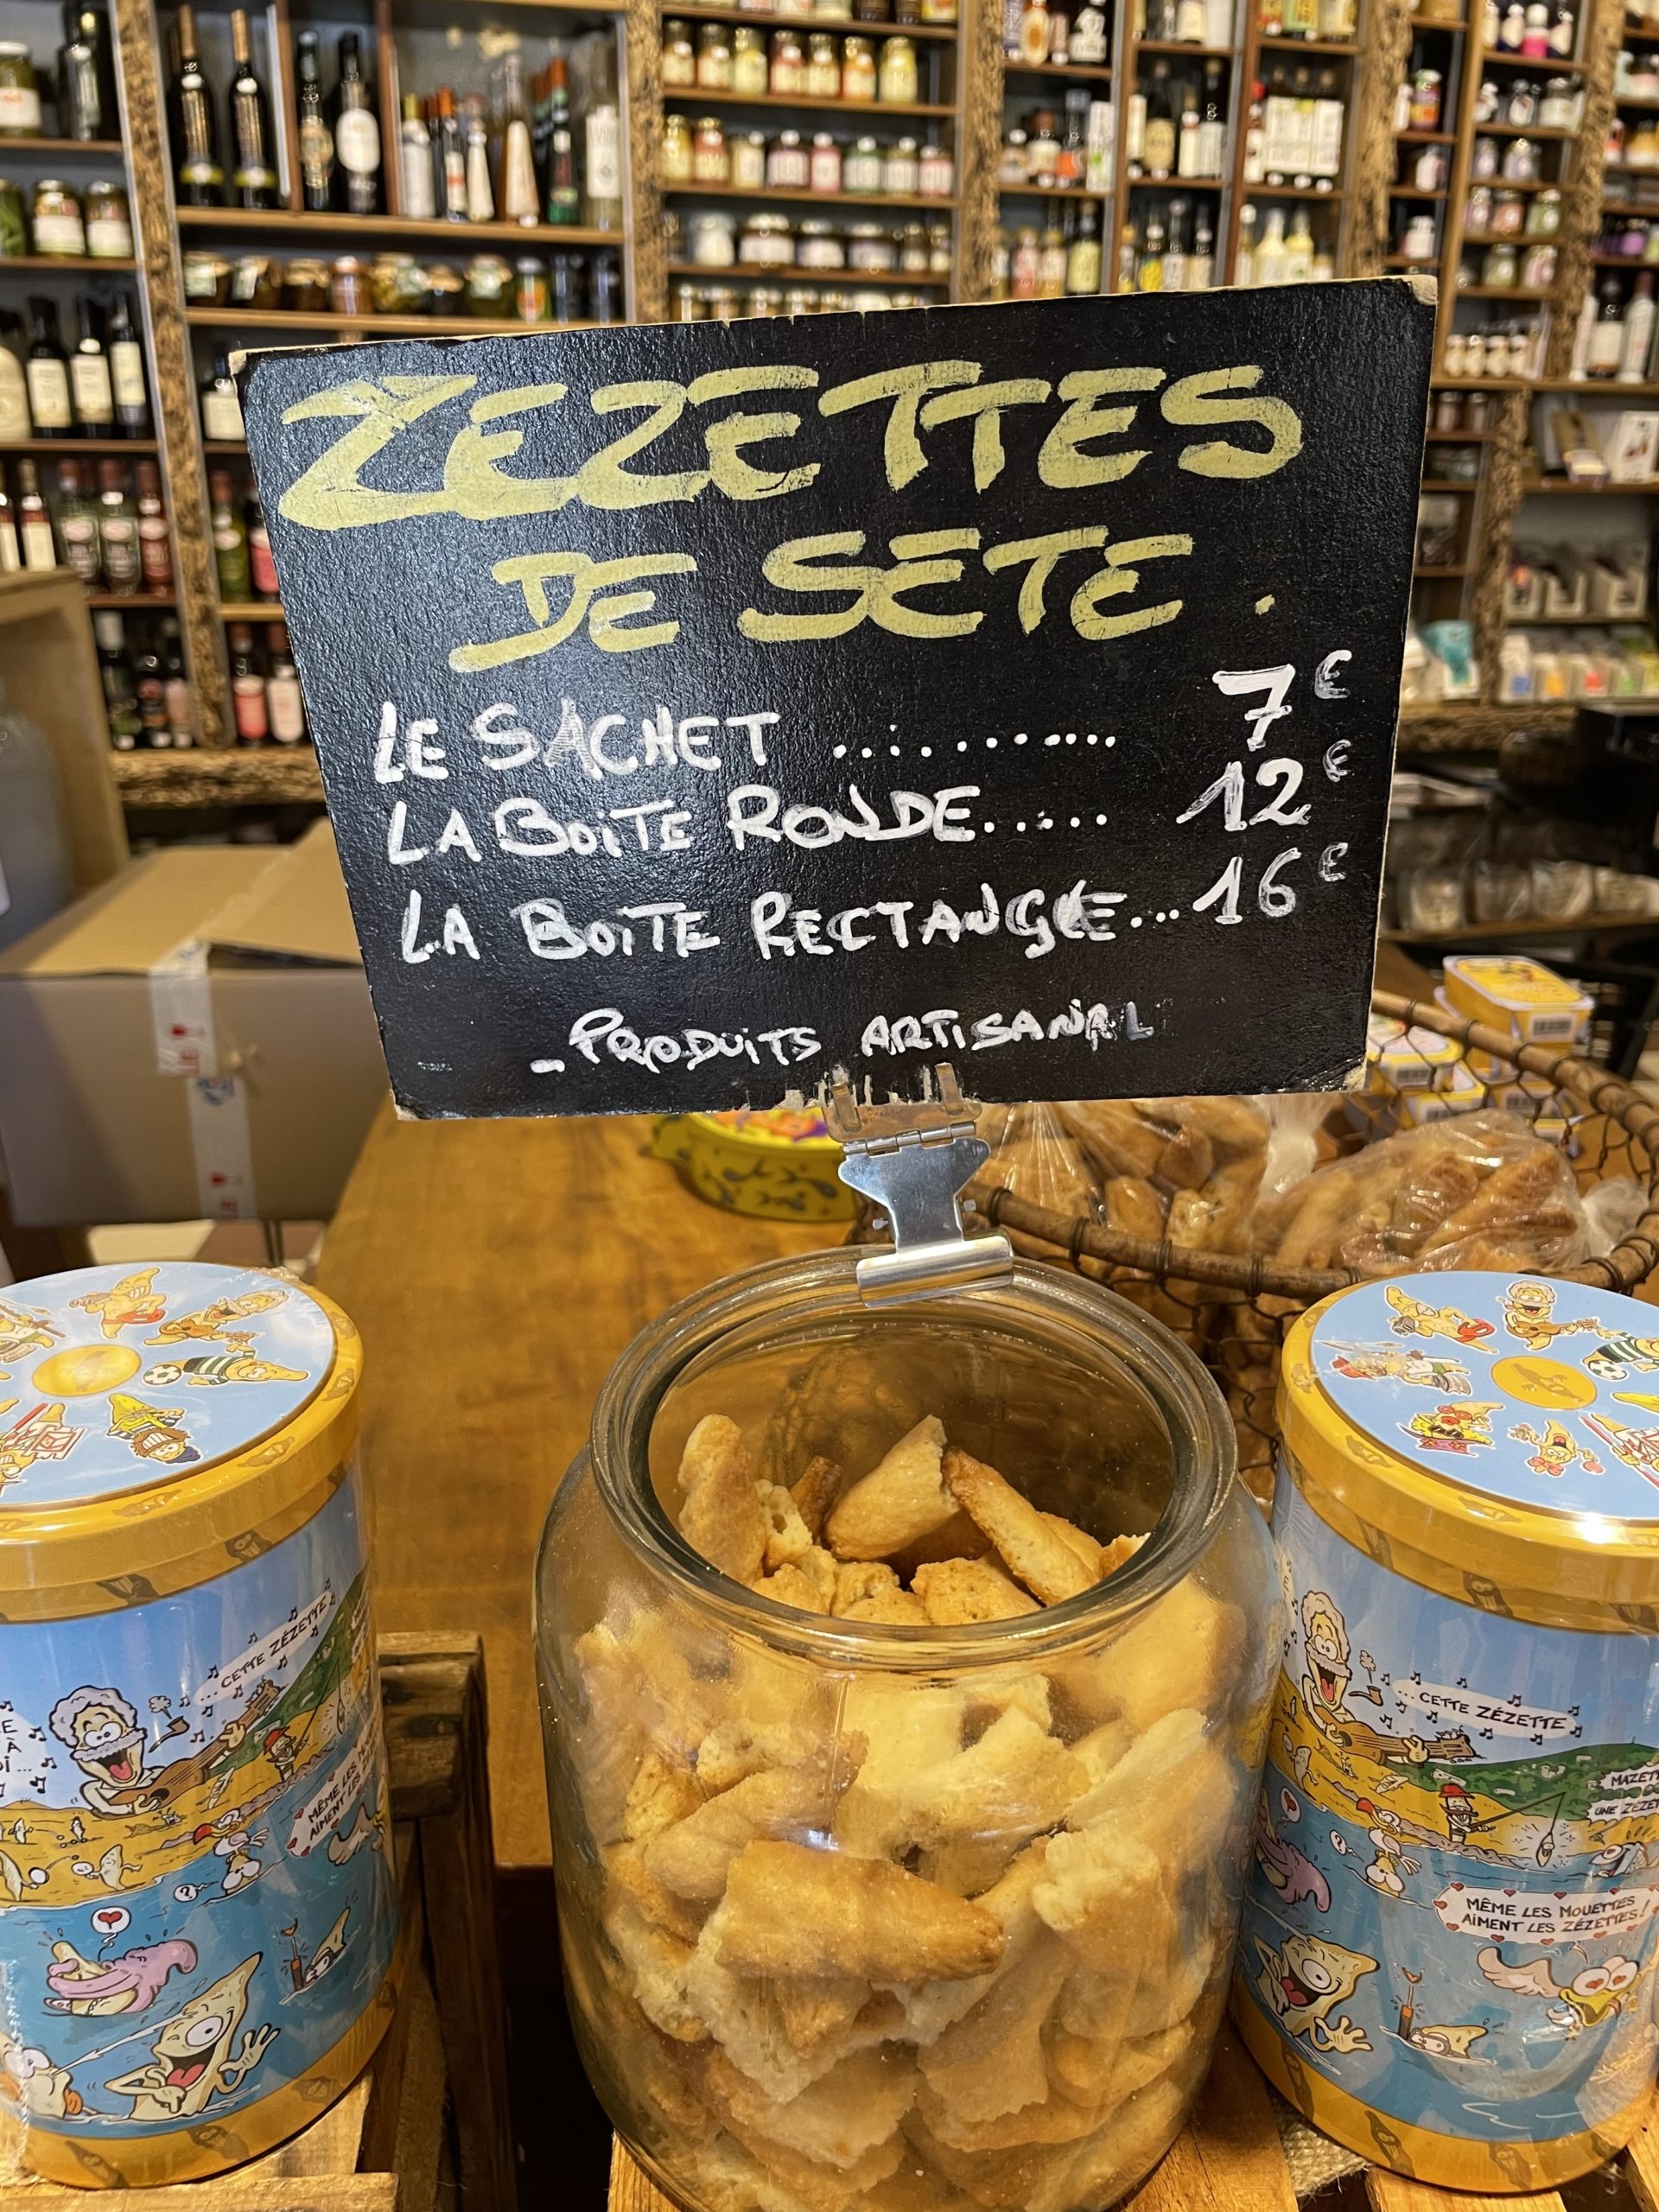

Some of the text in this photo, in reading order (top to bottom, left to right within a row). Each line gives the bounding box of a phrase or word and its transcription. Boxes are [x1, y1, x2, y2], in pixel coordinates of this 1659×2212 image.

[278, 359, 1304, 531] ZEZETTES
[448, 553, 697, 673] DE
[738, 526, 1194, 641] SETE
[373, 701, 449, 785] LE
[472, 696, 780, 779] SACHET
[1212, 663, 1296, 752] 7
[388, 800, 482, 864] LA
[1175, 760, 1312, 832] 12
[401, 890, 481, 963] LA
[1192, 848, 1302, 925] 16
[221, 1652, 265, 1689] CETTE
[270, 1595, 327, 1657] ZÉZETTE
[1420, 1692, 1470, 1714] CETTE
[1475, 1705, 1567, 1730] ZÉZETTE
[308, 1784, 340, 1824] MÊME
[1594, 1805, 1618, 1815] UNE
[1466, 1896, 1636, 1918] MÊME LES MOUETTES
[1527, 1923, 1556, 1933] LES
